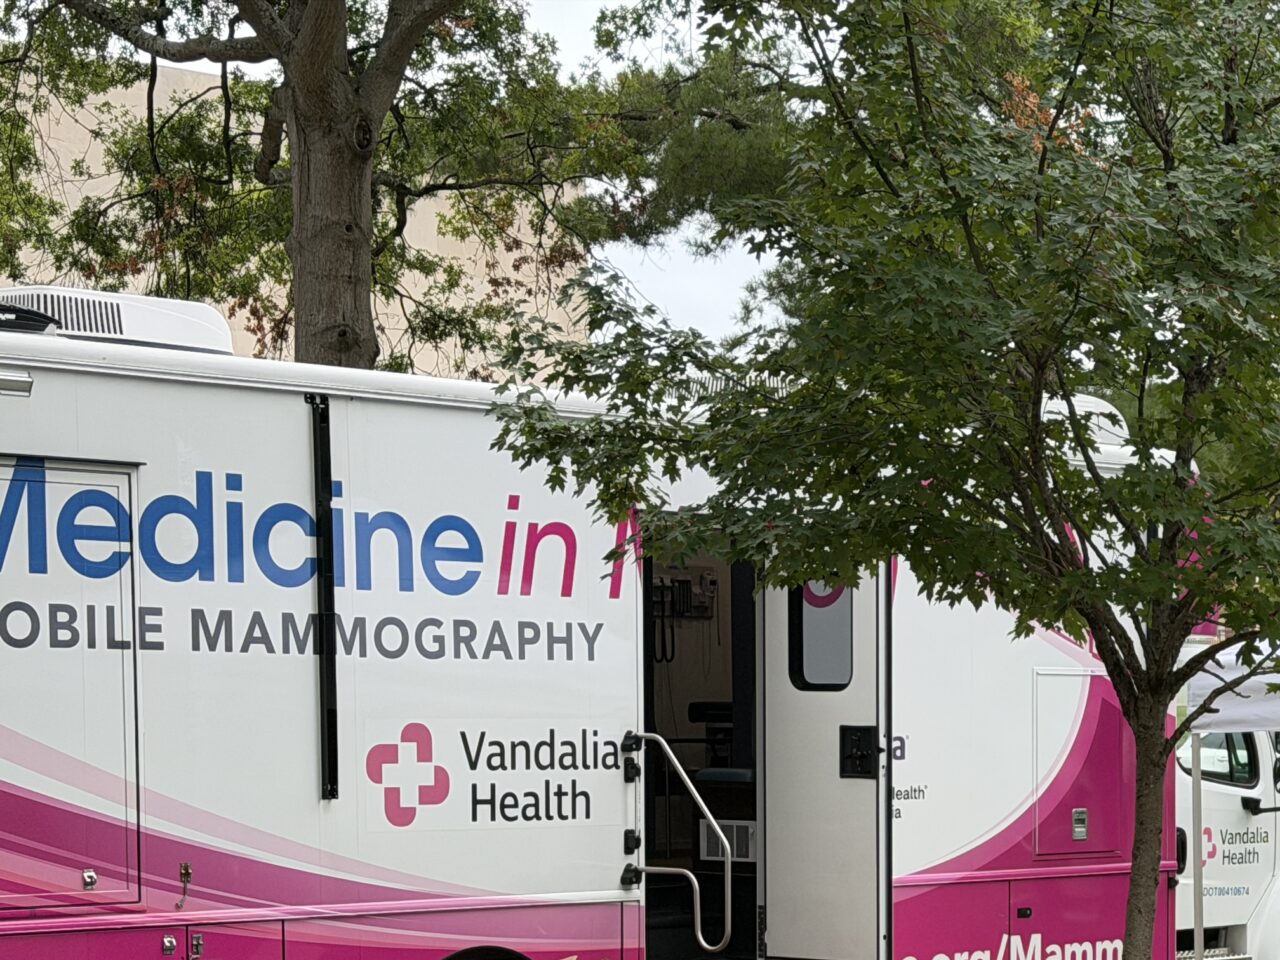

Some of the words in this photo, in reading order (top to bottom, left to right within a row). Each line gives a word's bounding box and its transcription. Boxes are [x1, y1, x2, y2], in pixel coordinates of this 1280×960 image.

[497, 495, 577, 597] in
[191, 608, 604, 661] MAMMOGRAPHY
[459, 729, 621, 771] Vandalia
[471, 780, 592, 823] Health
[1220, 827, 1269, 845] Vandalia
[1222, 848, 1259, 865] Health
